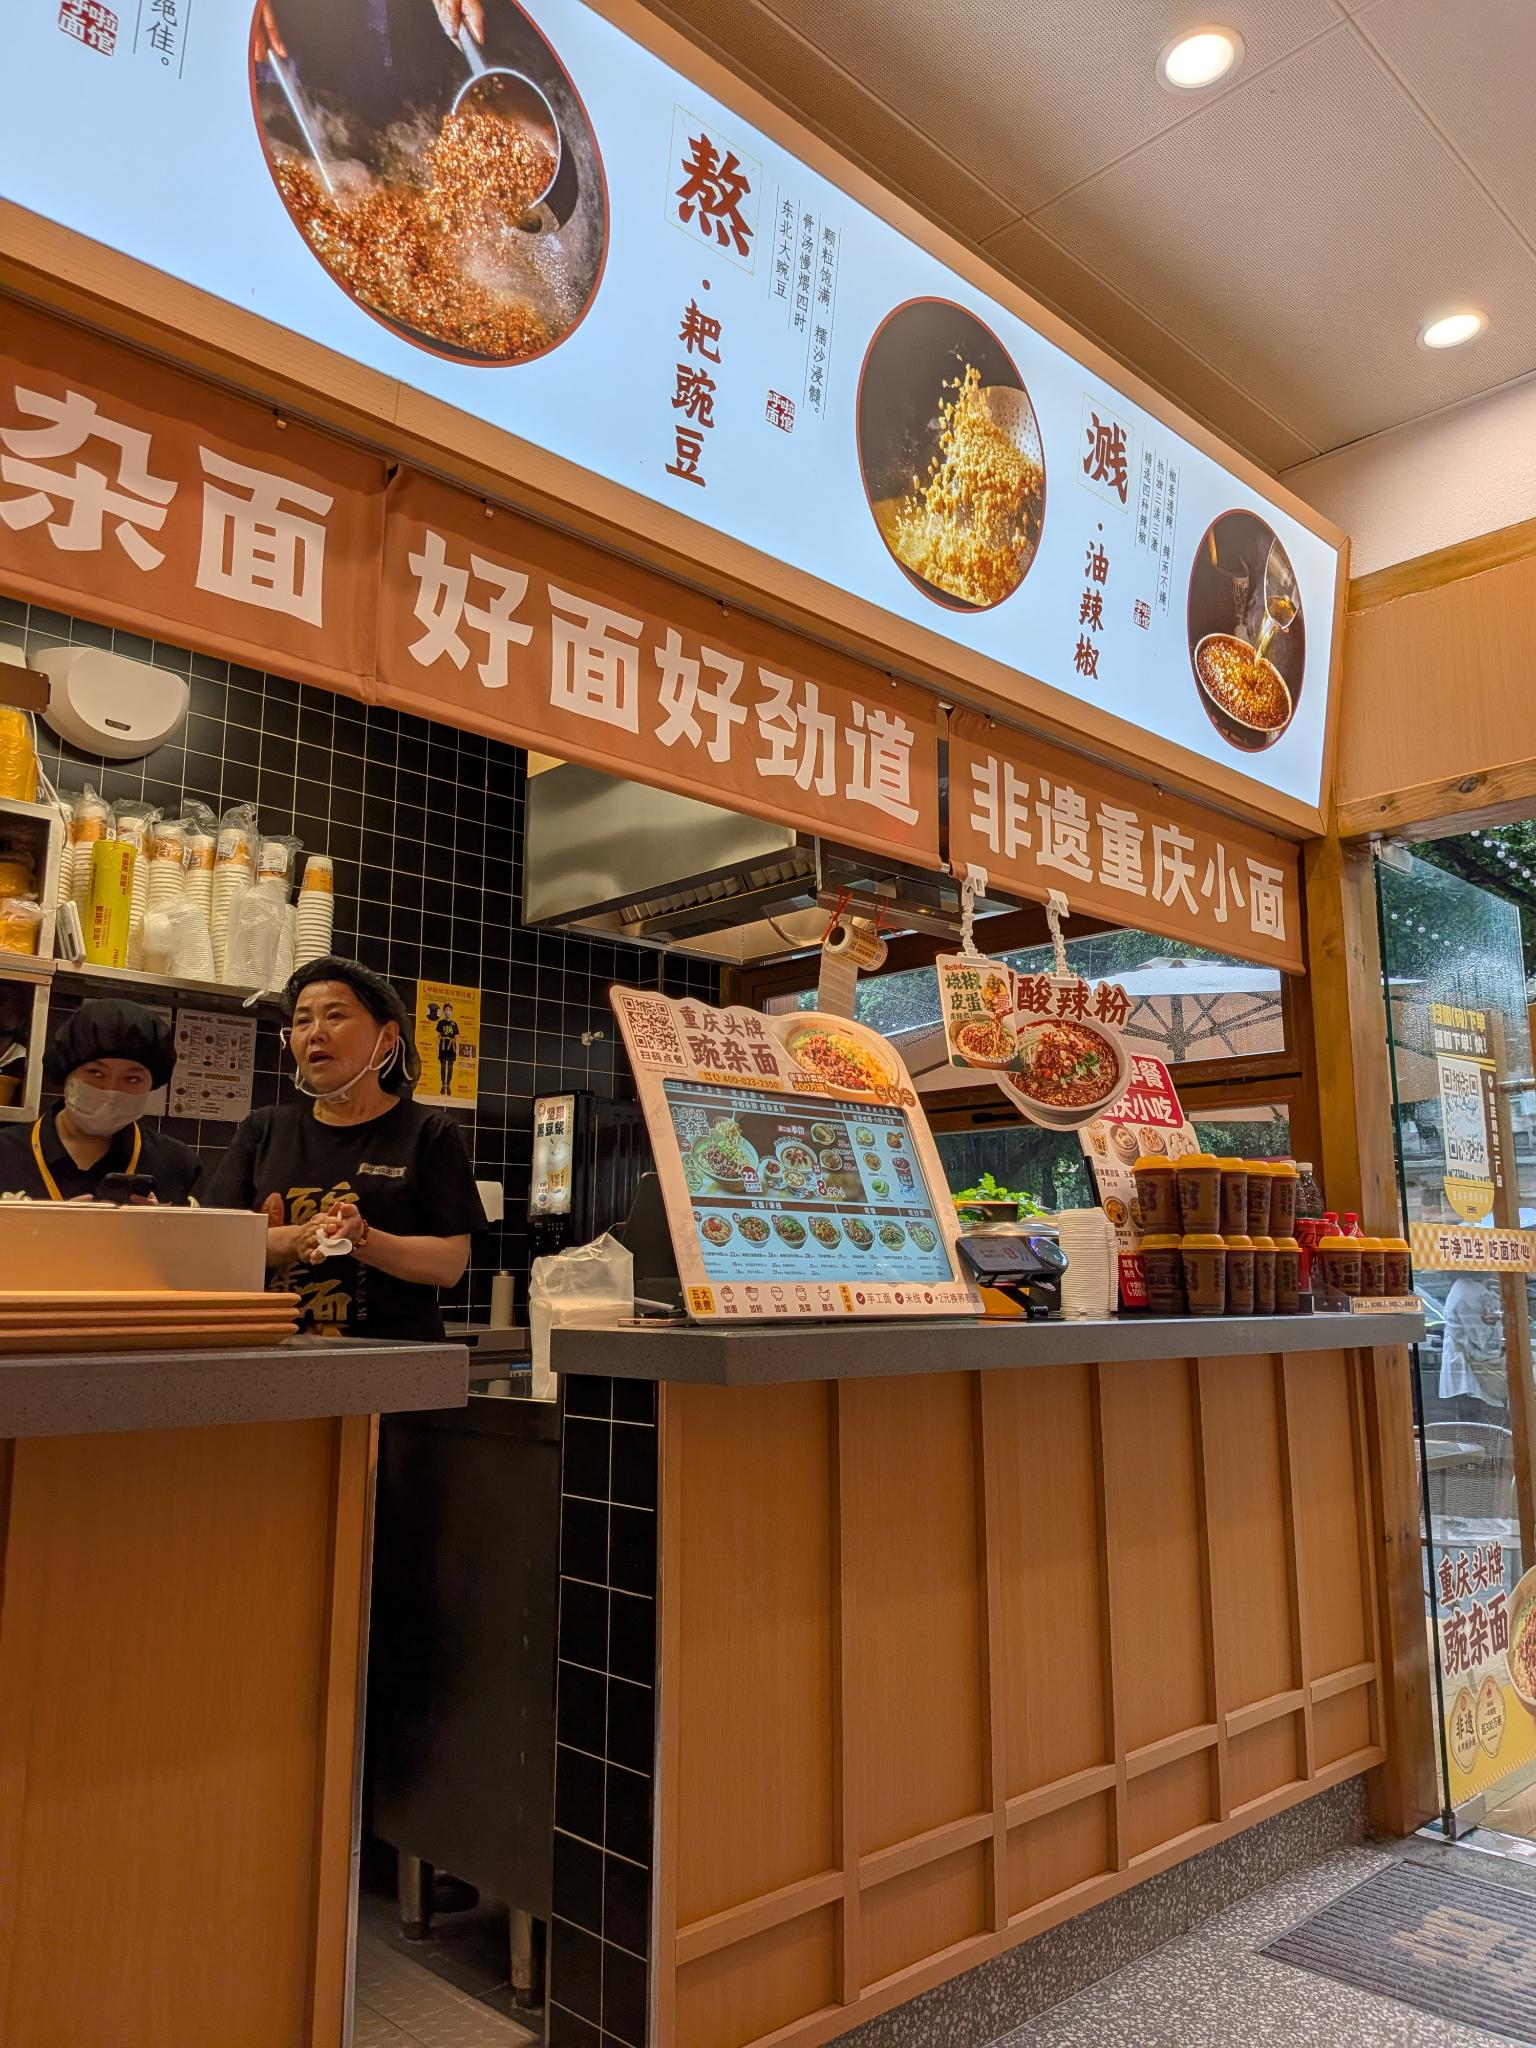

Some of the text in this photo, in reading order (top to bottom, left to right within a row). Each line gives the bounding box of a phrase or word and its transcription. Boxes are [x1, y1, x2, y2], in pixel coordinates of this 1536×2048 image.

[60, 9, 117, 56] 面馆
[676, 133, 754, 257] 熬
[773, 199, 794, 299] 东北大豌豆
[1083, 411, 1128, 504] 溅
[0, 384, 335, 629] 杂面
[407, 530, 920, 827] 好面好劲道
[970, 755, 1287, 942] 非遗重庆小面
[946, 971, 982, 991] 烧椒
[951, 992, 982, 1012] 皮蛋
[1017, 976, 1131, 1026] 酸辣粉
[678, 1005, 766, 1041] 重庆头牌
[639, 1049, 684, 1065] 扫码点餐
[687, 1034, 781, 1076] 豌杂面
[723, 1075, 779, 1090] 400-023-2300
[1105, 1093, 1177, 1125] 庆小吃
[1439, 1237, 1530, 1261] 干净卫生 吃面放心
[692, 1289, 709, 1300] 五大
[694, 1300, 713, 1311] 免费
[865, 1292, 892, 1305] 手工面
[905, 1292, 922, 1304] 米线
[1438, 1540, 1504, 1605] 重庆头牌
[1443, 1592, 1509, 1677] 豌杂面
[1456, 1709, 1474, 1740] 非遗
